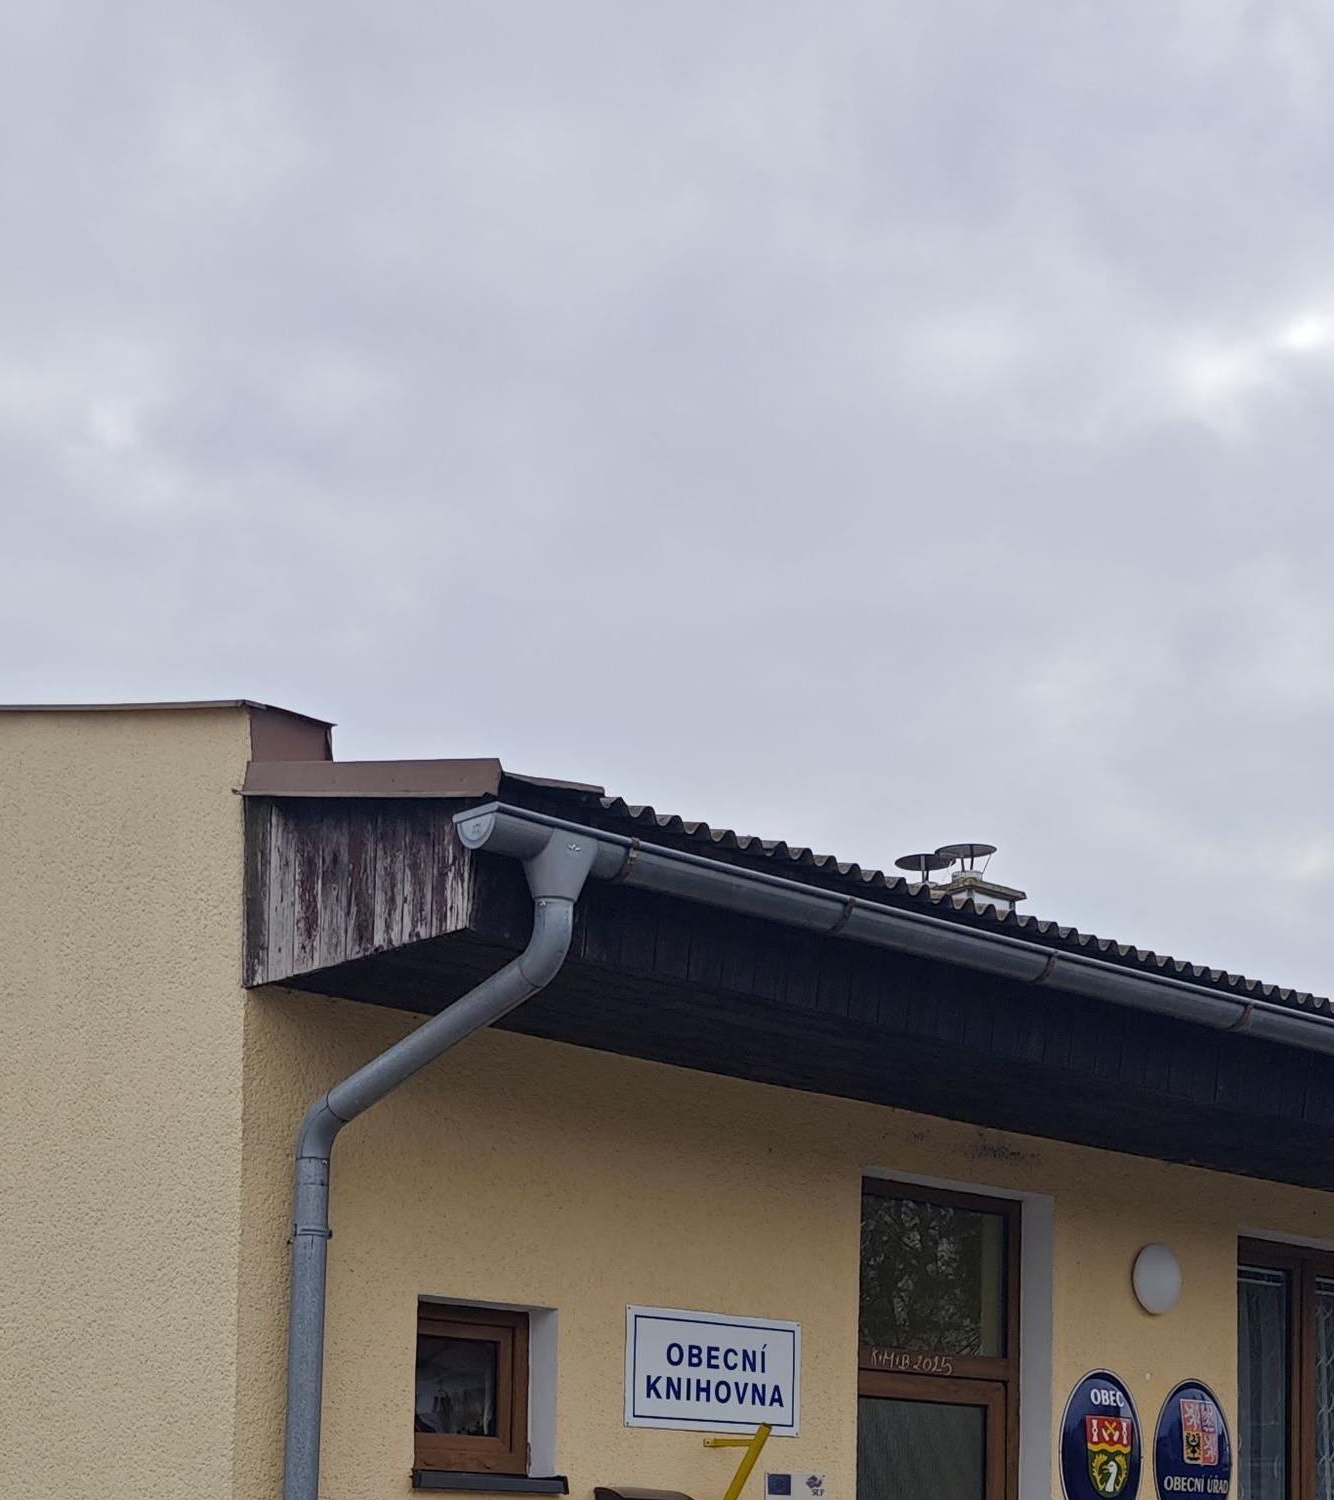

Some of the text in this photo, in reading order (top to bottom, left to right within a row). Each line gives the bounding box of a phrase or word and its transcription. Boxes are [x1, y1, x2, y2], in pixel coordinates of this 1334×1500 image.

[666, 1342, 768, 1374] OBECNÍ
[913, 1355, 954, 1376] 2025
[645, 1374, 785, 1408] KNIHOVNA
[1090, 1388, 1125, 1408] OBEC
[1163, 1474, 1229, 1494] OBECNÍ ÚŘAD
